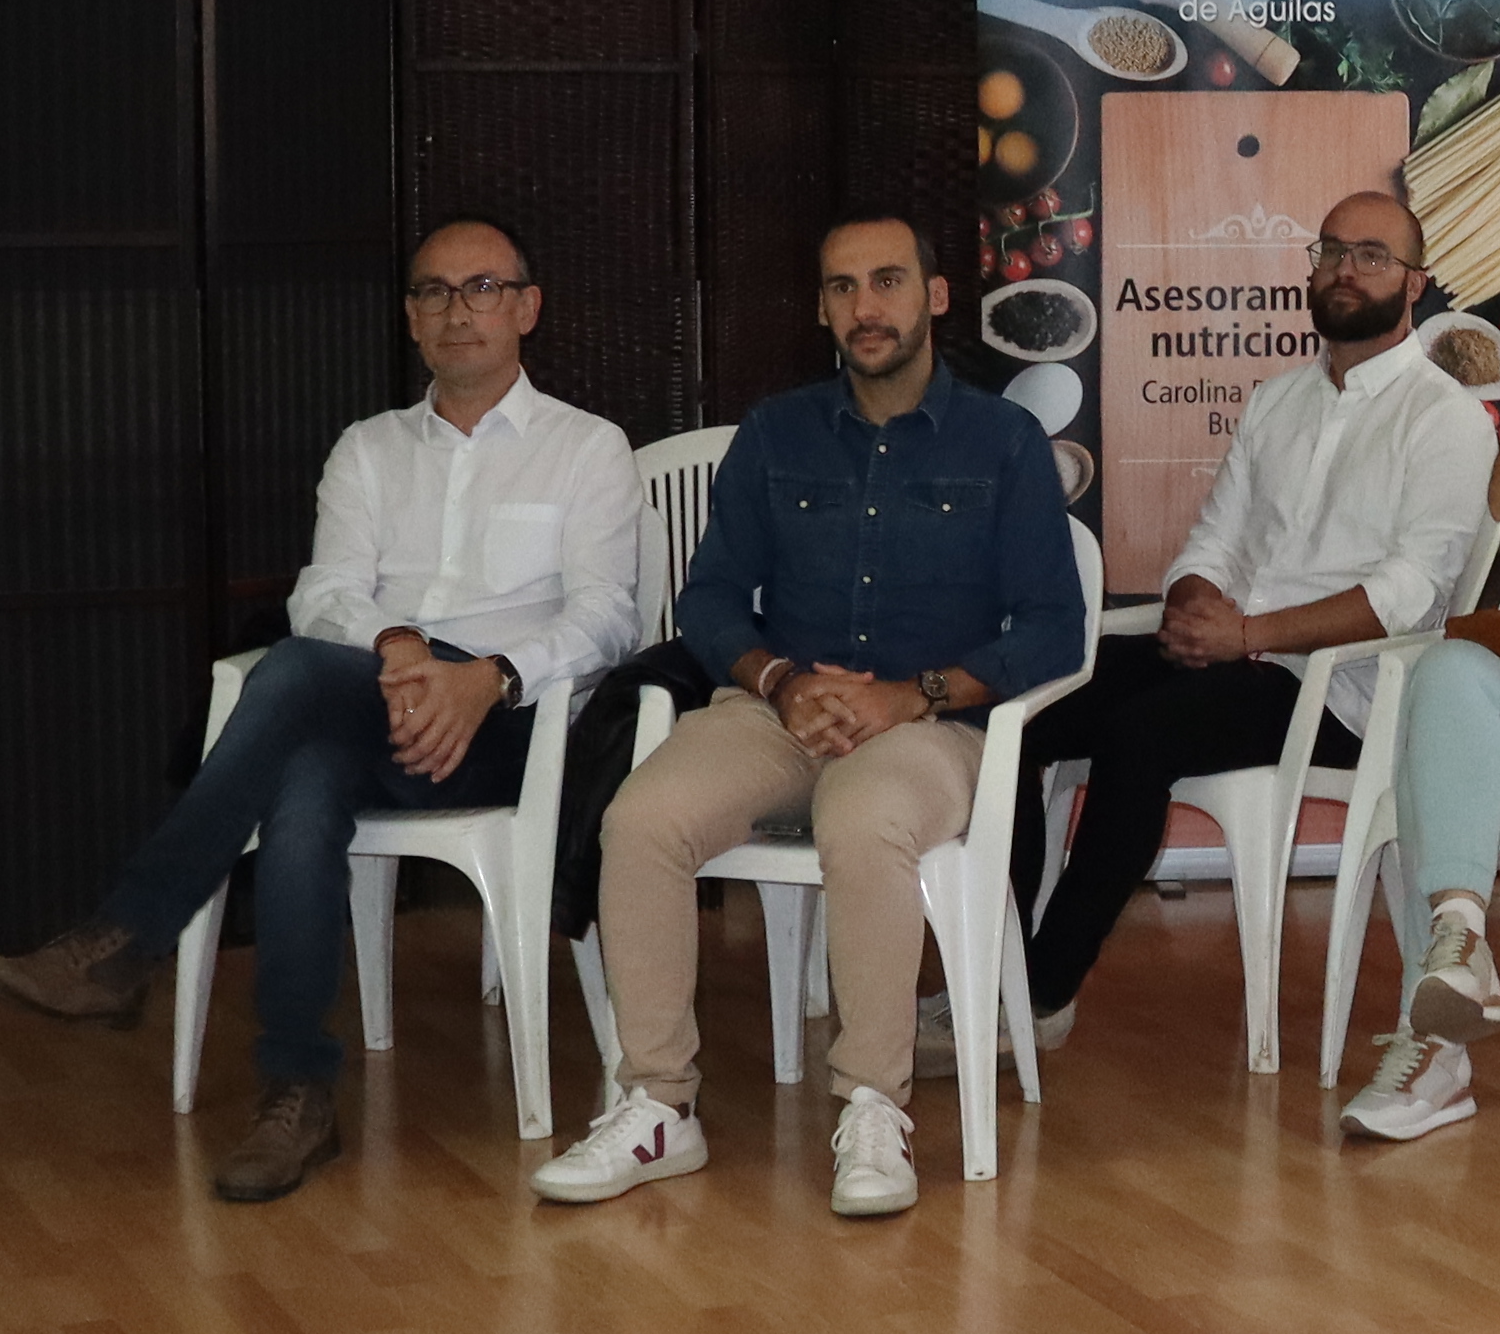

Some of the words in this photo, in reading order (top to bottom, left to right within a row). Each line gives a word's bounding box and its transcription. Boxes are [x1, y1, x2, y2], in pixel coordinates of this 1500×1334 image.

[1116, 276, 1312, 312] Asesorami
[1151, 322, 1320, 358] nutricion
[1142, 378, 1243, 405] Carolina
[1208, 411, 1239, 436] Bu
